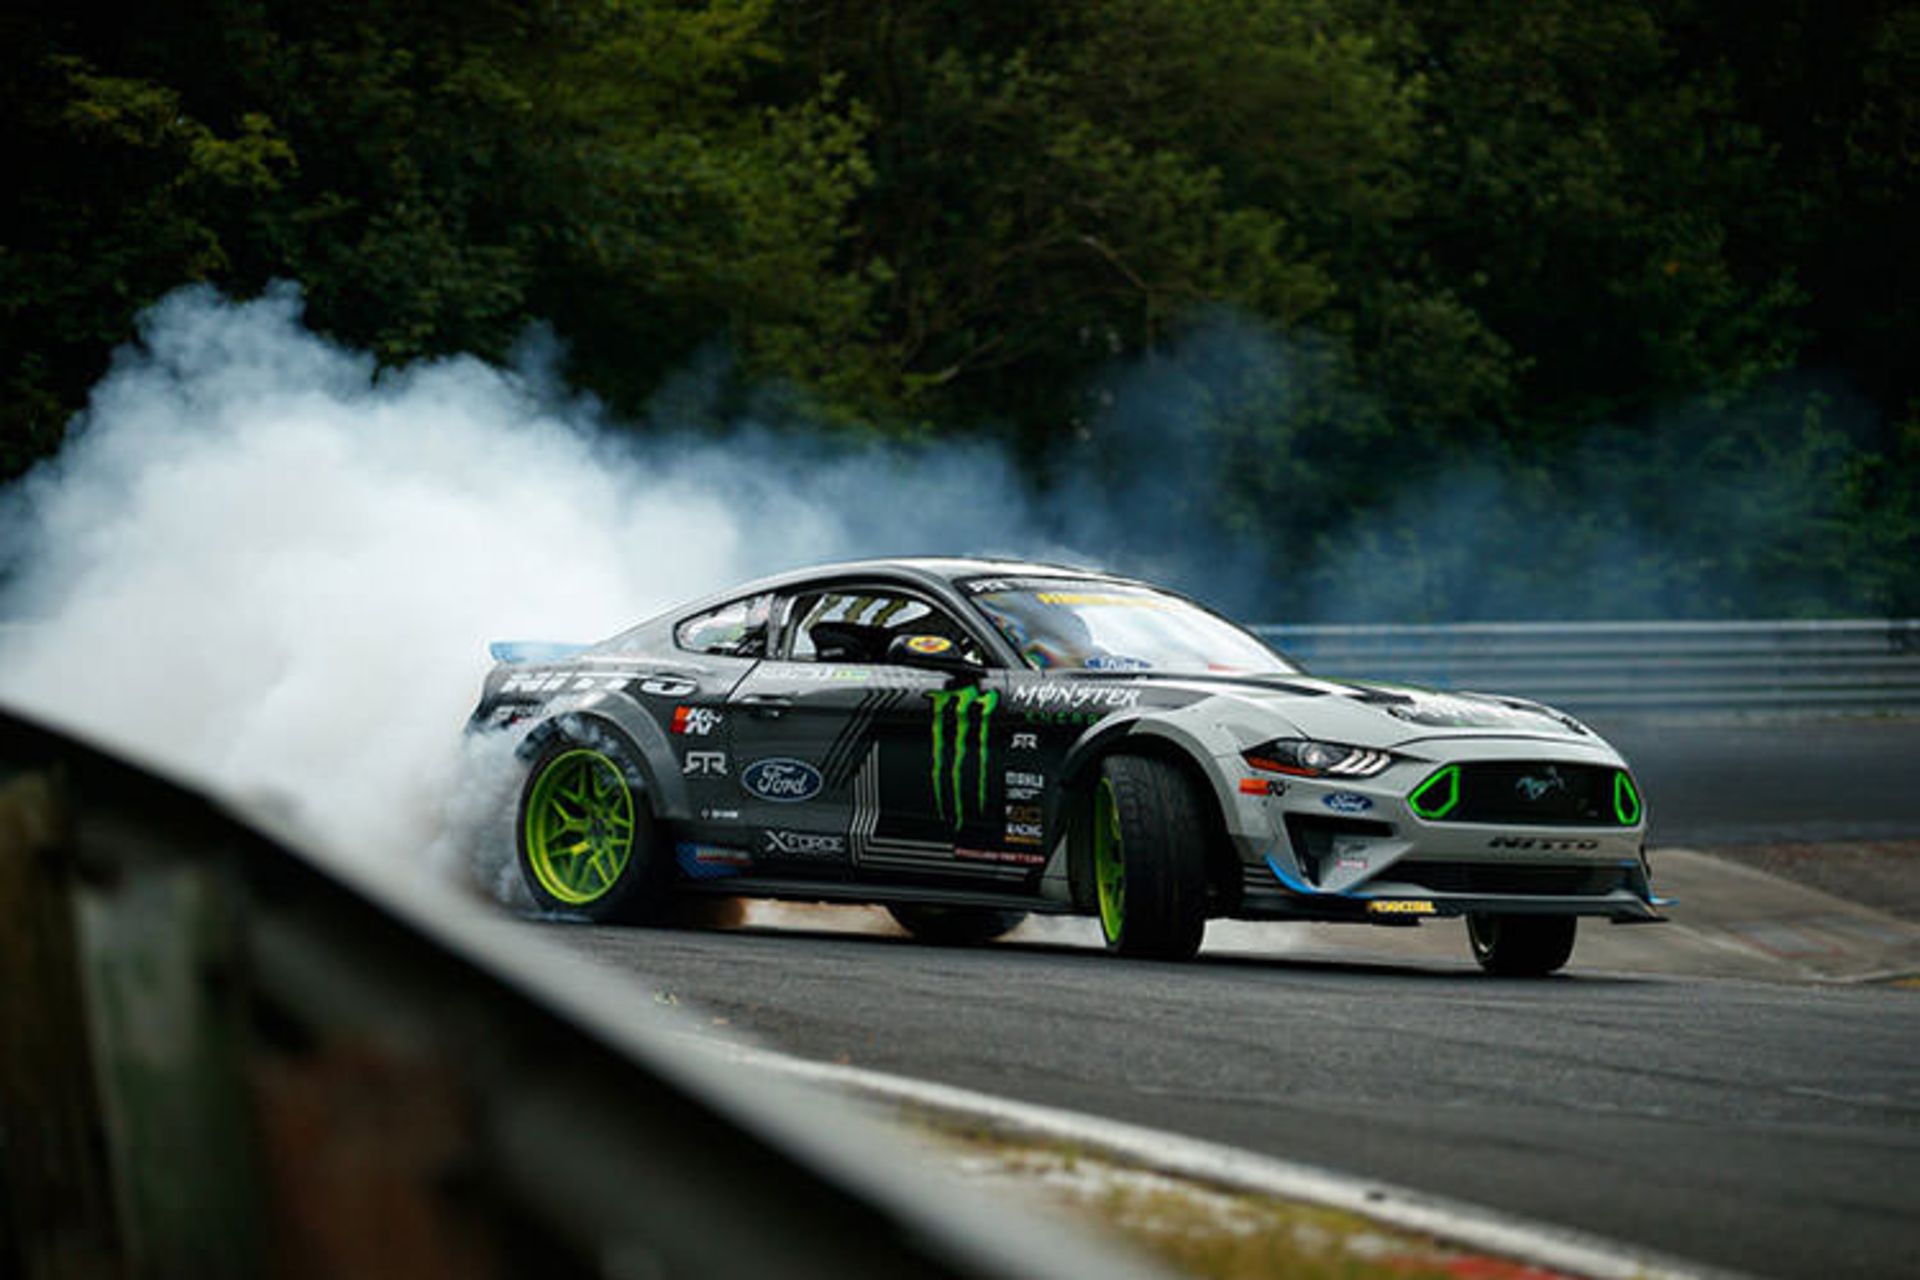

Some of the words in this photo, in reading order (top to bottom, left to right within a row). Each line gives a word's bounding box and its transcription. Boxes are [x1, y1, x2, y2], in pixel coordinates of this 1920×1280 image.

[684, 707, 722, 735] K&N
[683, 751, 728, 775] RTR
[756, 763, 808, 794] Ford
[1330, 792, 1364, 809] Ford
[1488, 836, 1599, 851] NITTO
